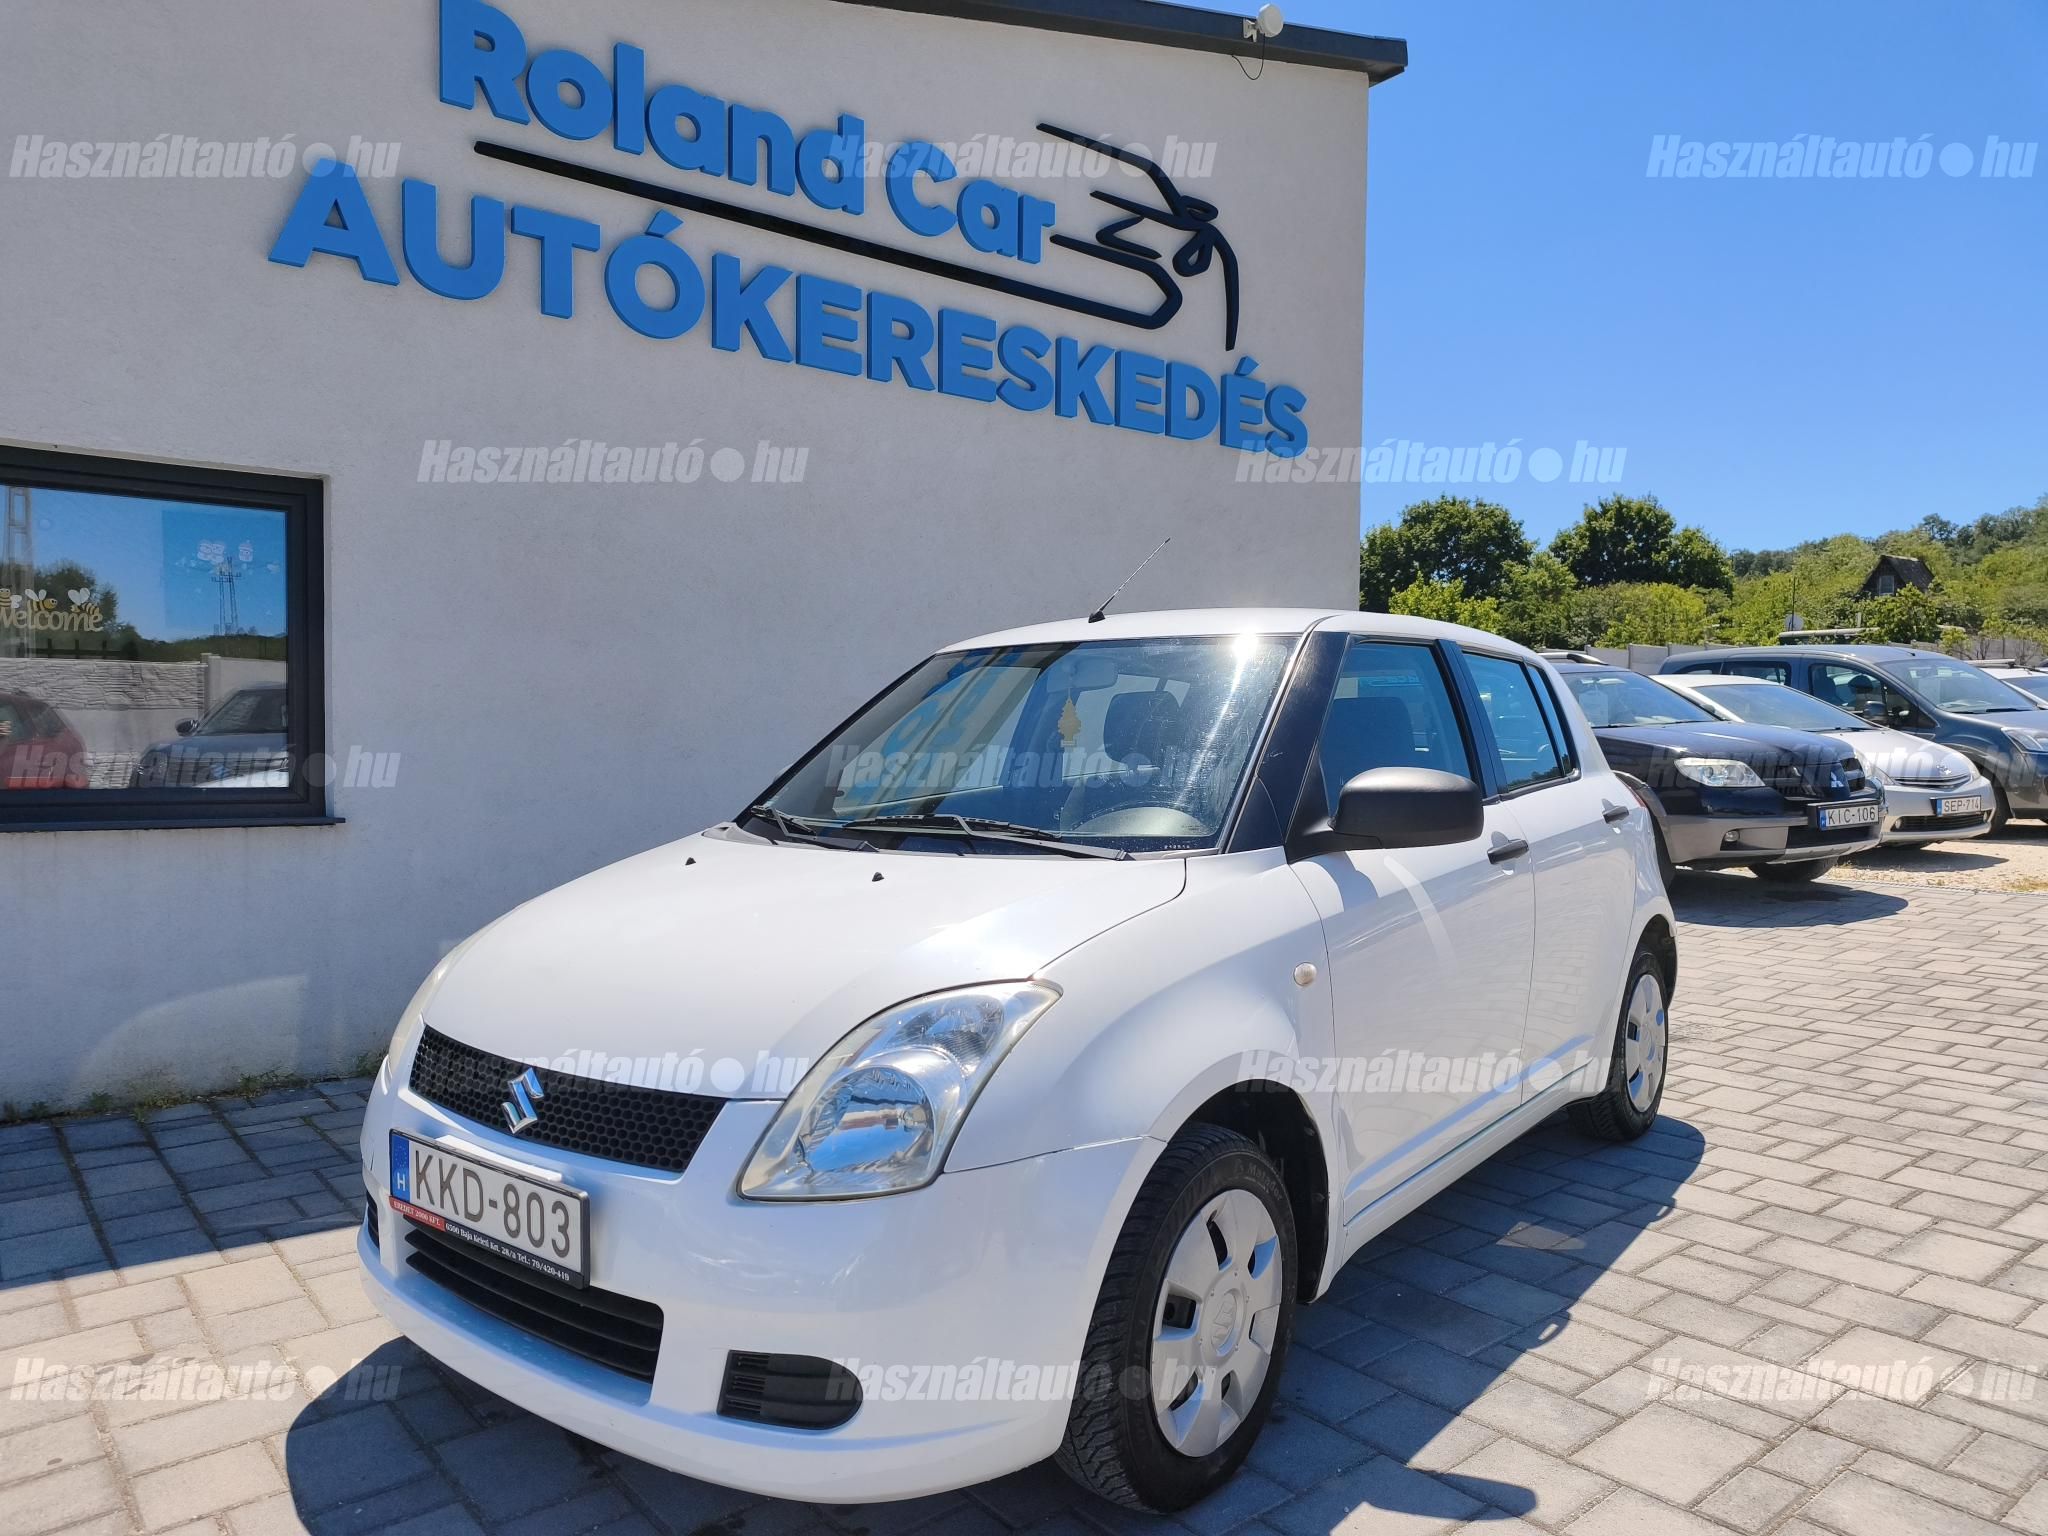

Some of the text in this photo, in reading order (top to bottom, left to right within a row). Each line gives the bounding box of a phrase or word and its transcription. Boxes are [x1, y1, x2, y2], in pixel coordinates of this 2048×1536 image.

[439, 0, 1056, 264] Roland Car
[268, 156, 1309, 460] AUTÓKERESKEDÉS
[1827, 806, 1876, 825] KIC-106
[396, 1171, 407, 1192] H
[415, 1149, 570, 1259] KKD-803
[460, 1229, 473, 1241] Baja
